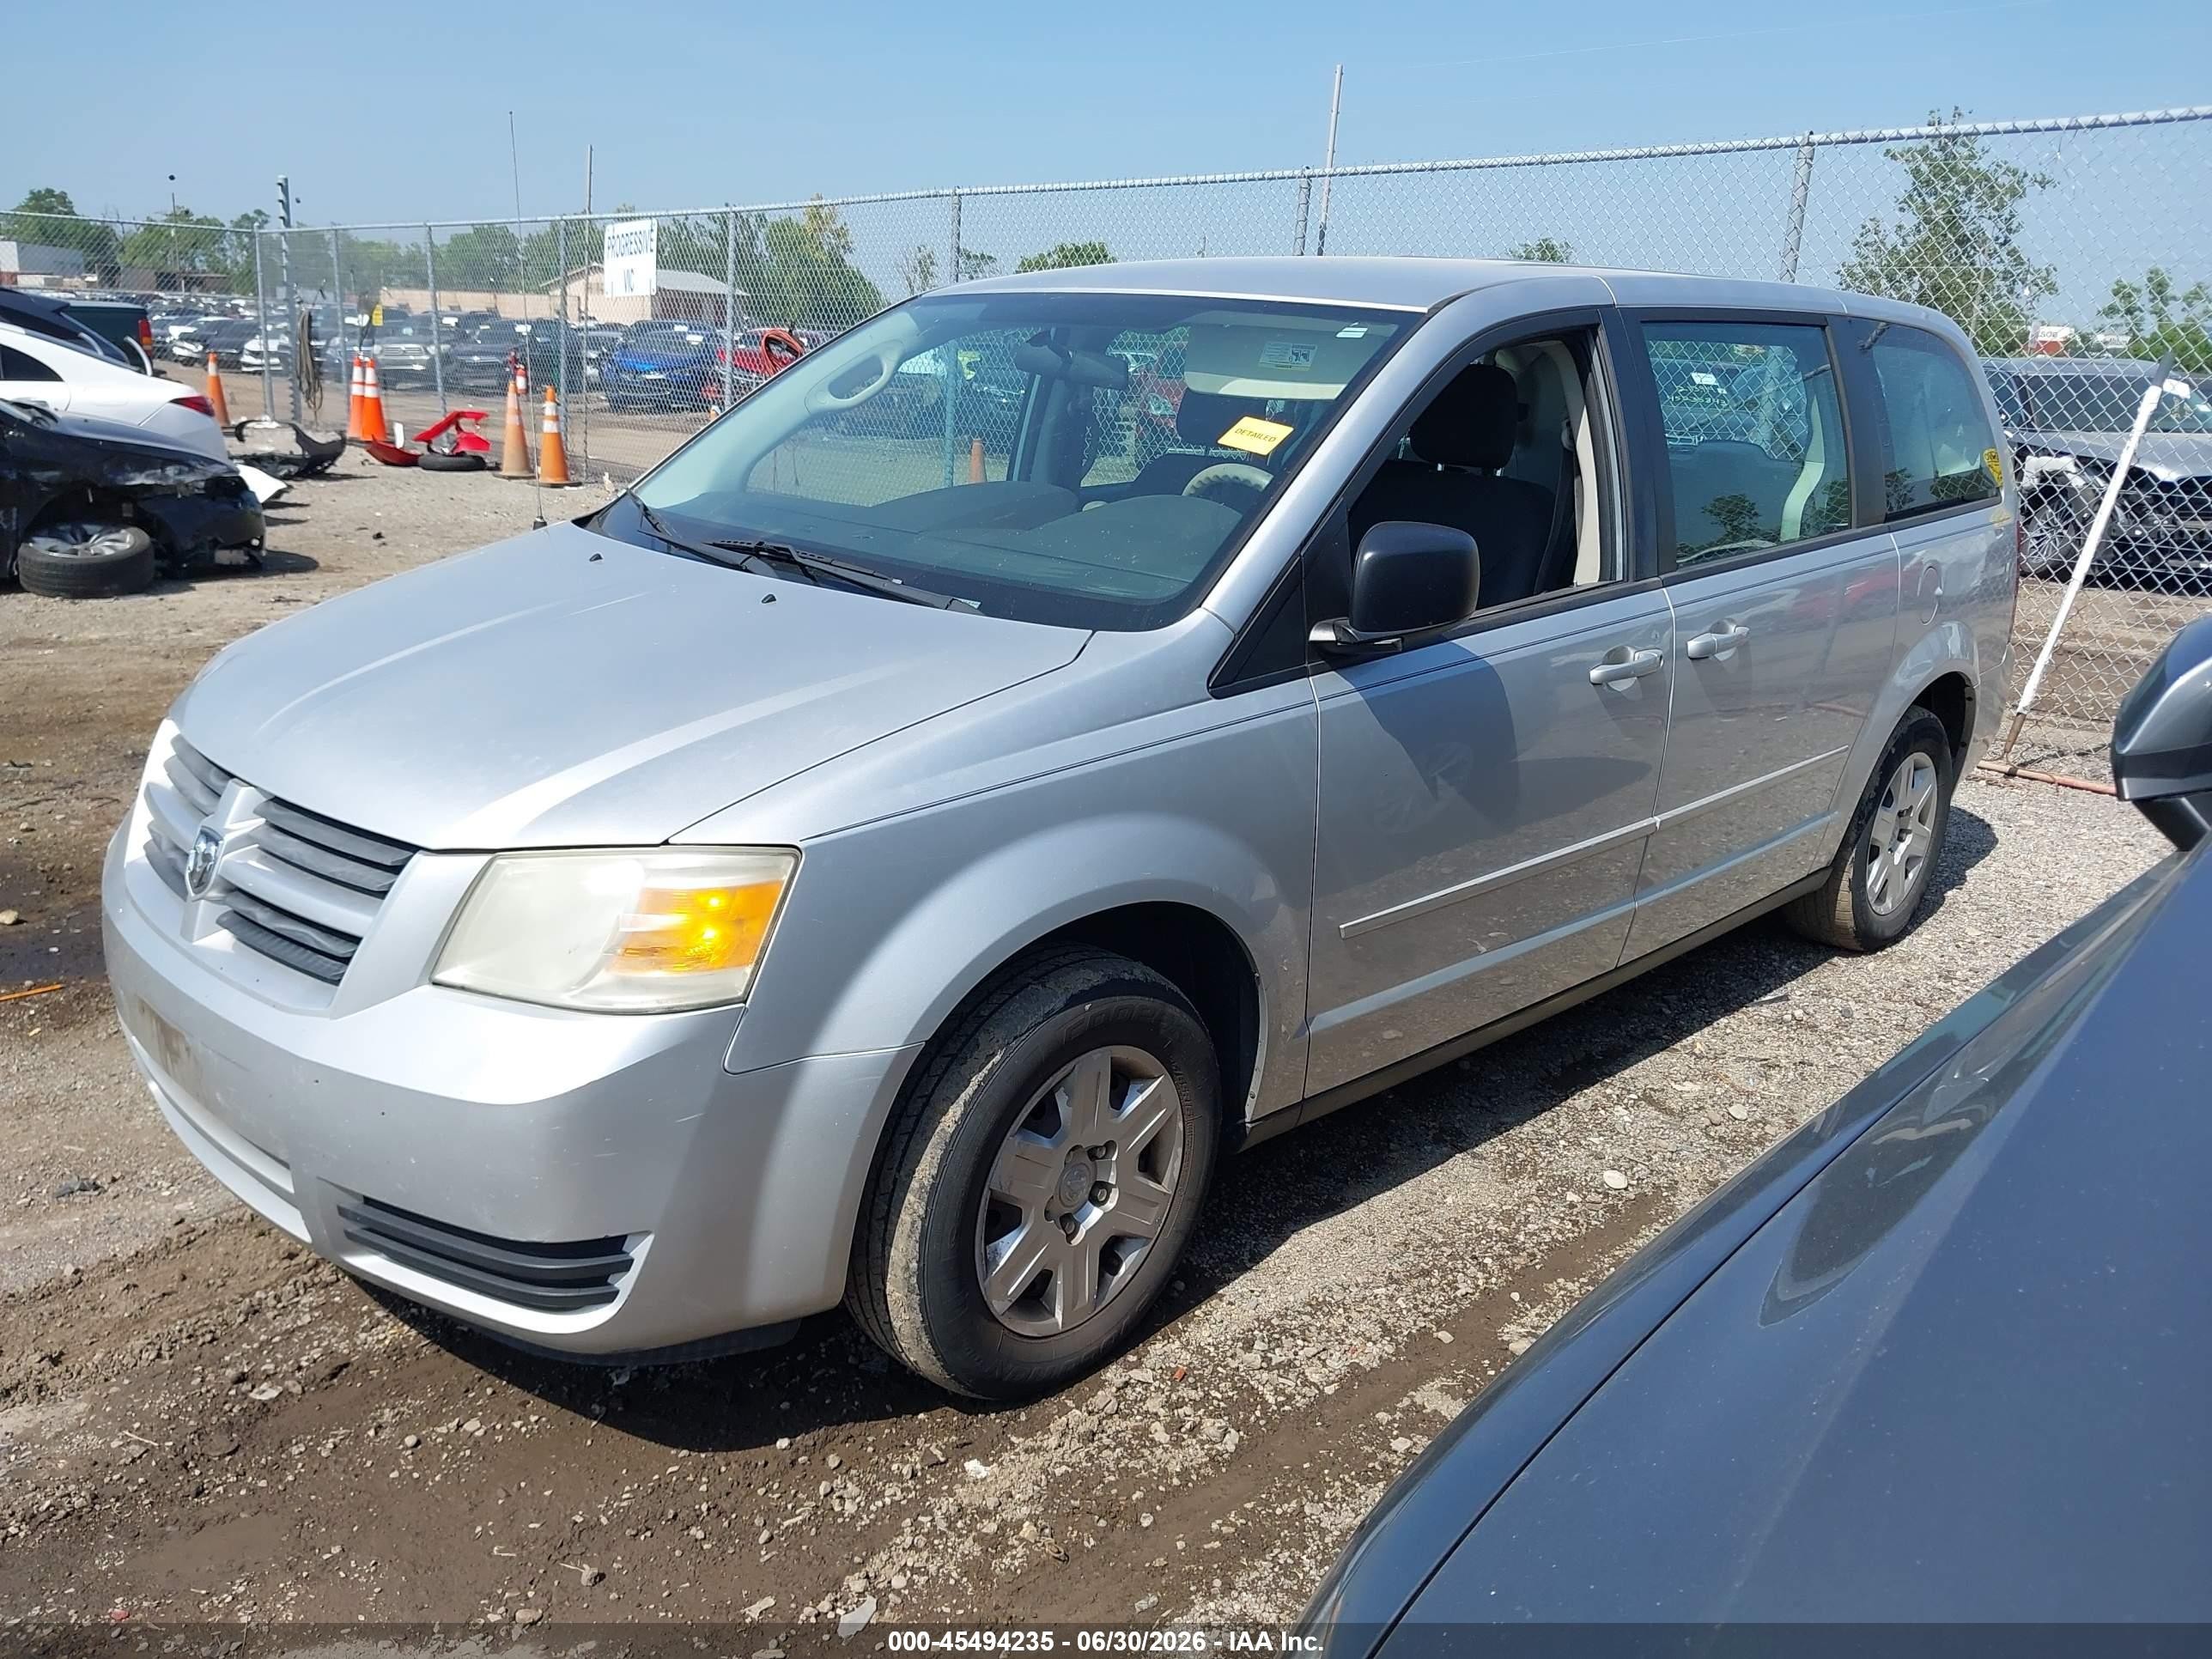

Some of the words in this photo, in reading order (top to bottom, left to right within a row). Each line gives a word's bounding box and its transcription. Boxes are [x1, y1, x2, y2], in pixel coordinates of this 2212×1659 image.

[607, 228, 654, 258] PROGRESSIVE
[623, 268, 635, 293] VIC
[1235, 428, 1277, 442] DETAILED
